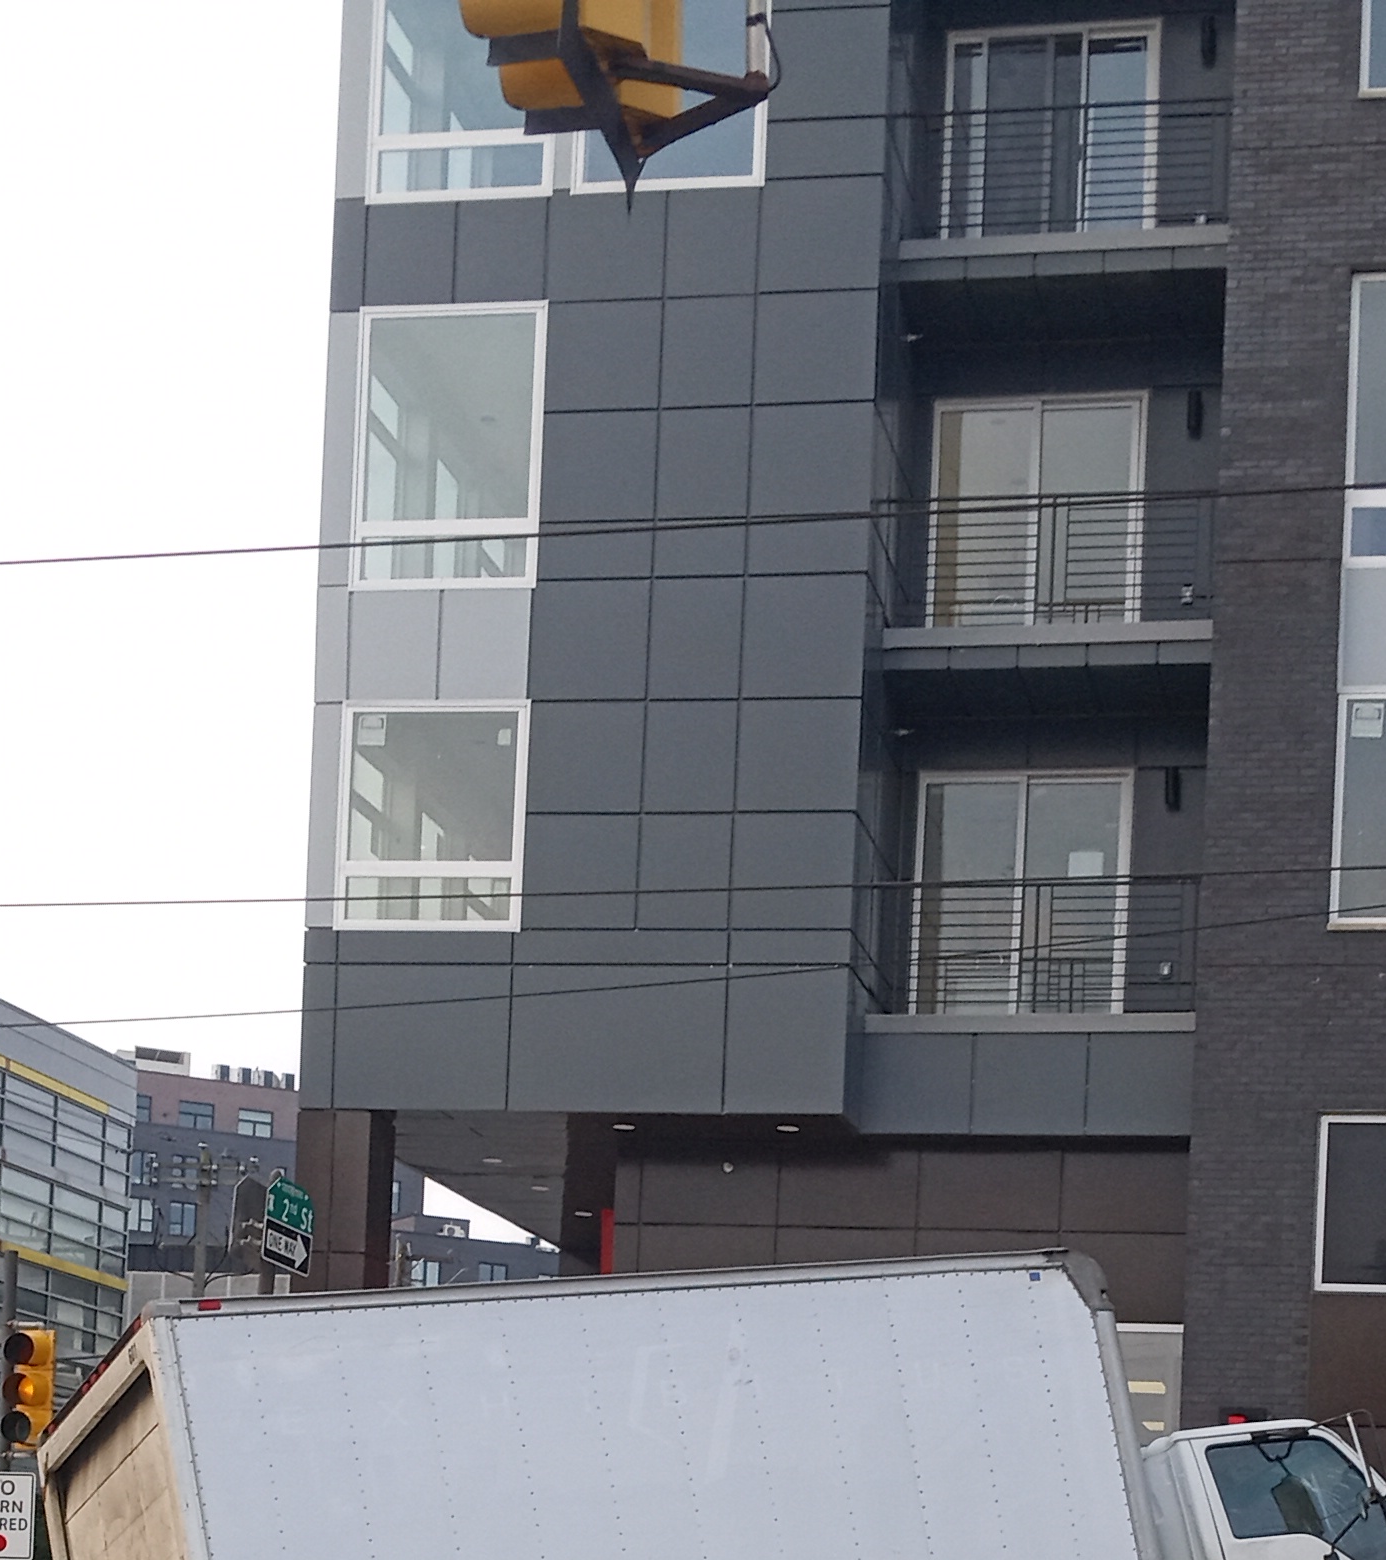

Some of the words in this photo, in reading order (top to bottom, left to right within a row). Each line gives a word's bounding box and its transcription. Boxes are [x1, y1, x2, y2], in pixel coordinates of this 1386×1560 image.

[299, 1207, 314, 1233] St
[268, 1231, 283, 1252] ONE
[0, 1517, 28, 1531] RED
